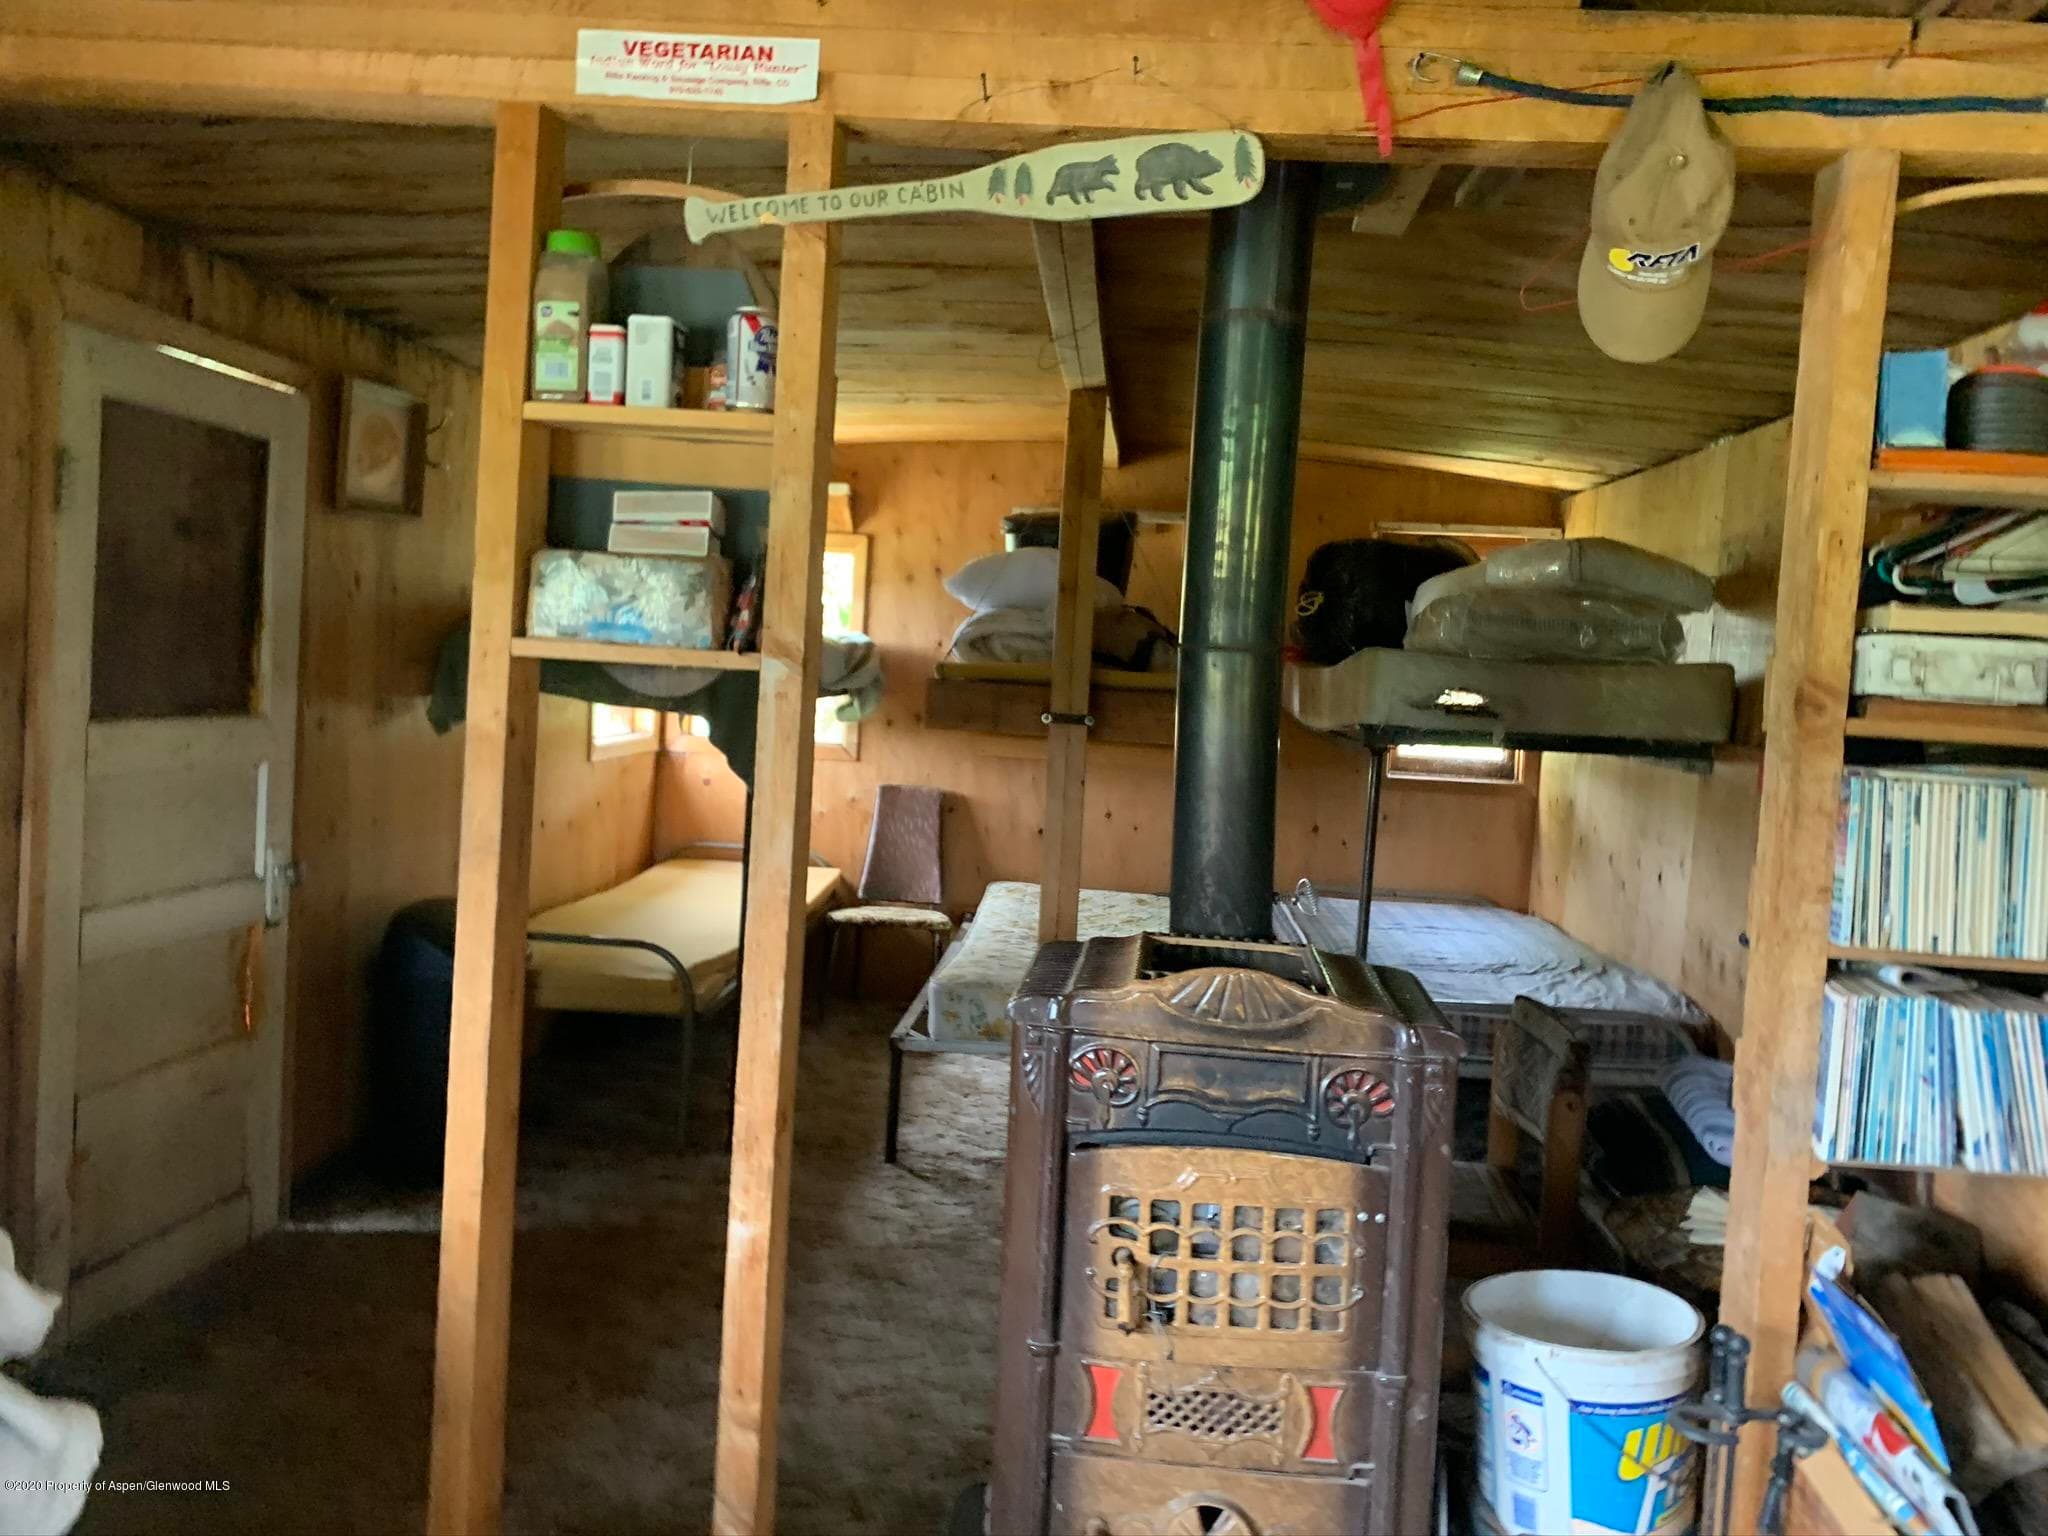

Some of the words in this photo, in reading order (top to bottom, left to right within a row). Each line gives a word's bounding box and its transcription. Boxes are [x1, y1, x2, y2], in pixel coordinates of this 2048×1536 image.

[623, 40, 774, 62] VEGETARIAN
[706, 197, 809, 223] WELCOME
[817, 195, 842, 211] TO
[850, 189, 889, 208] OUR
[897, 180, 965, 205] CABIN
